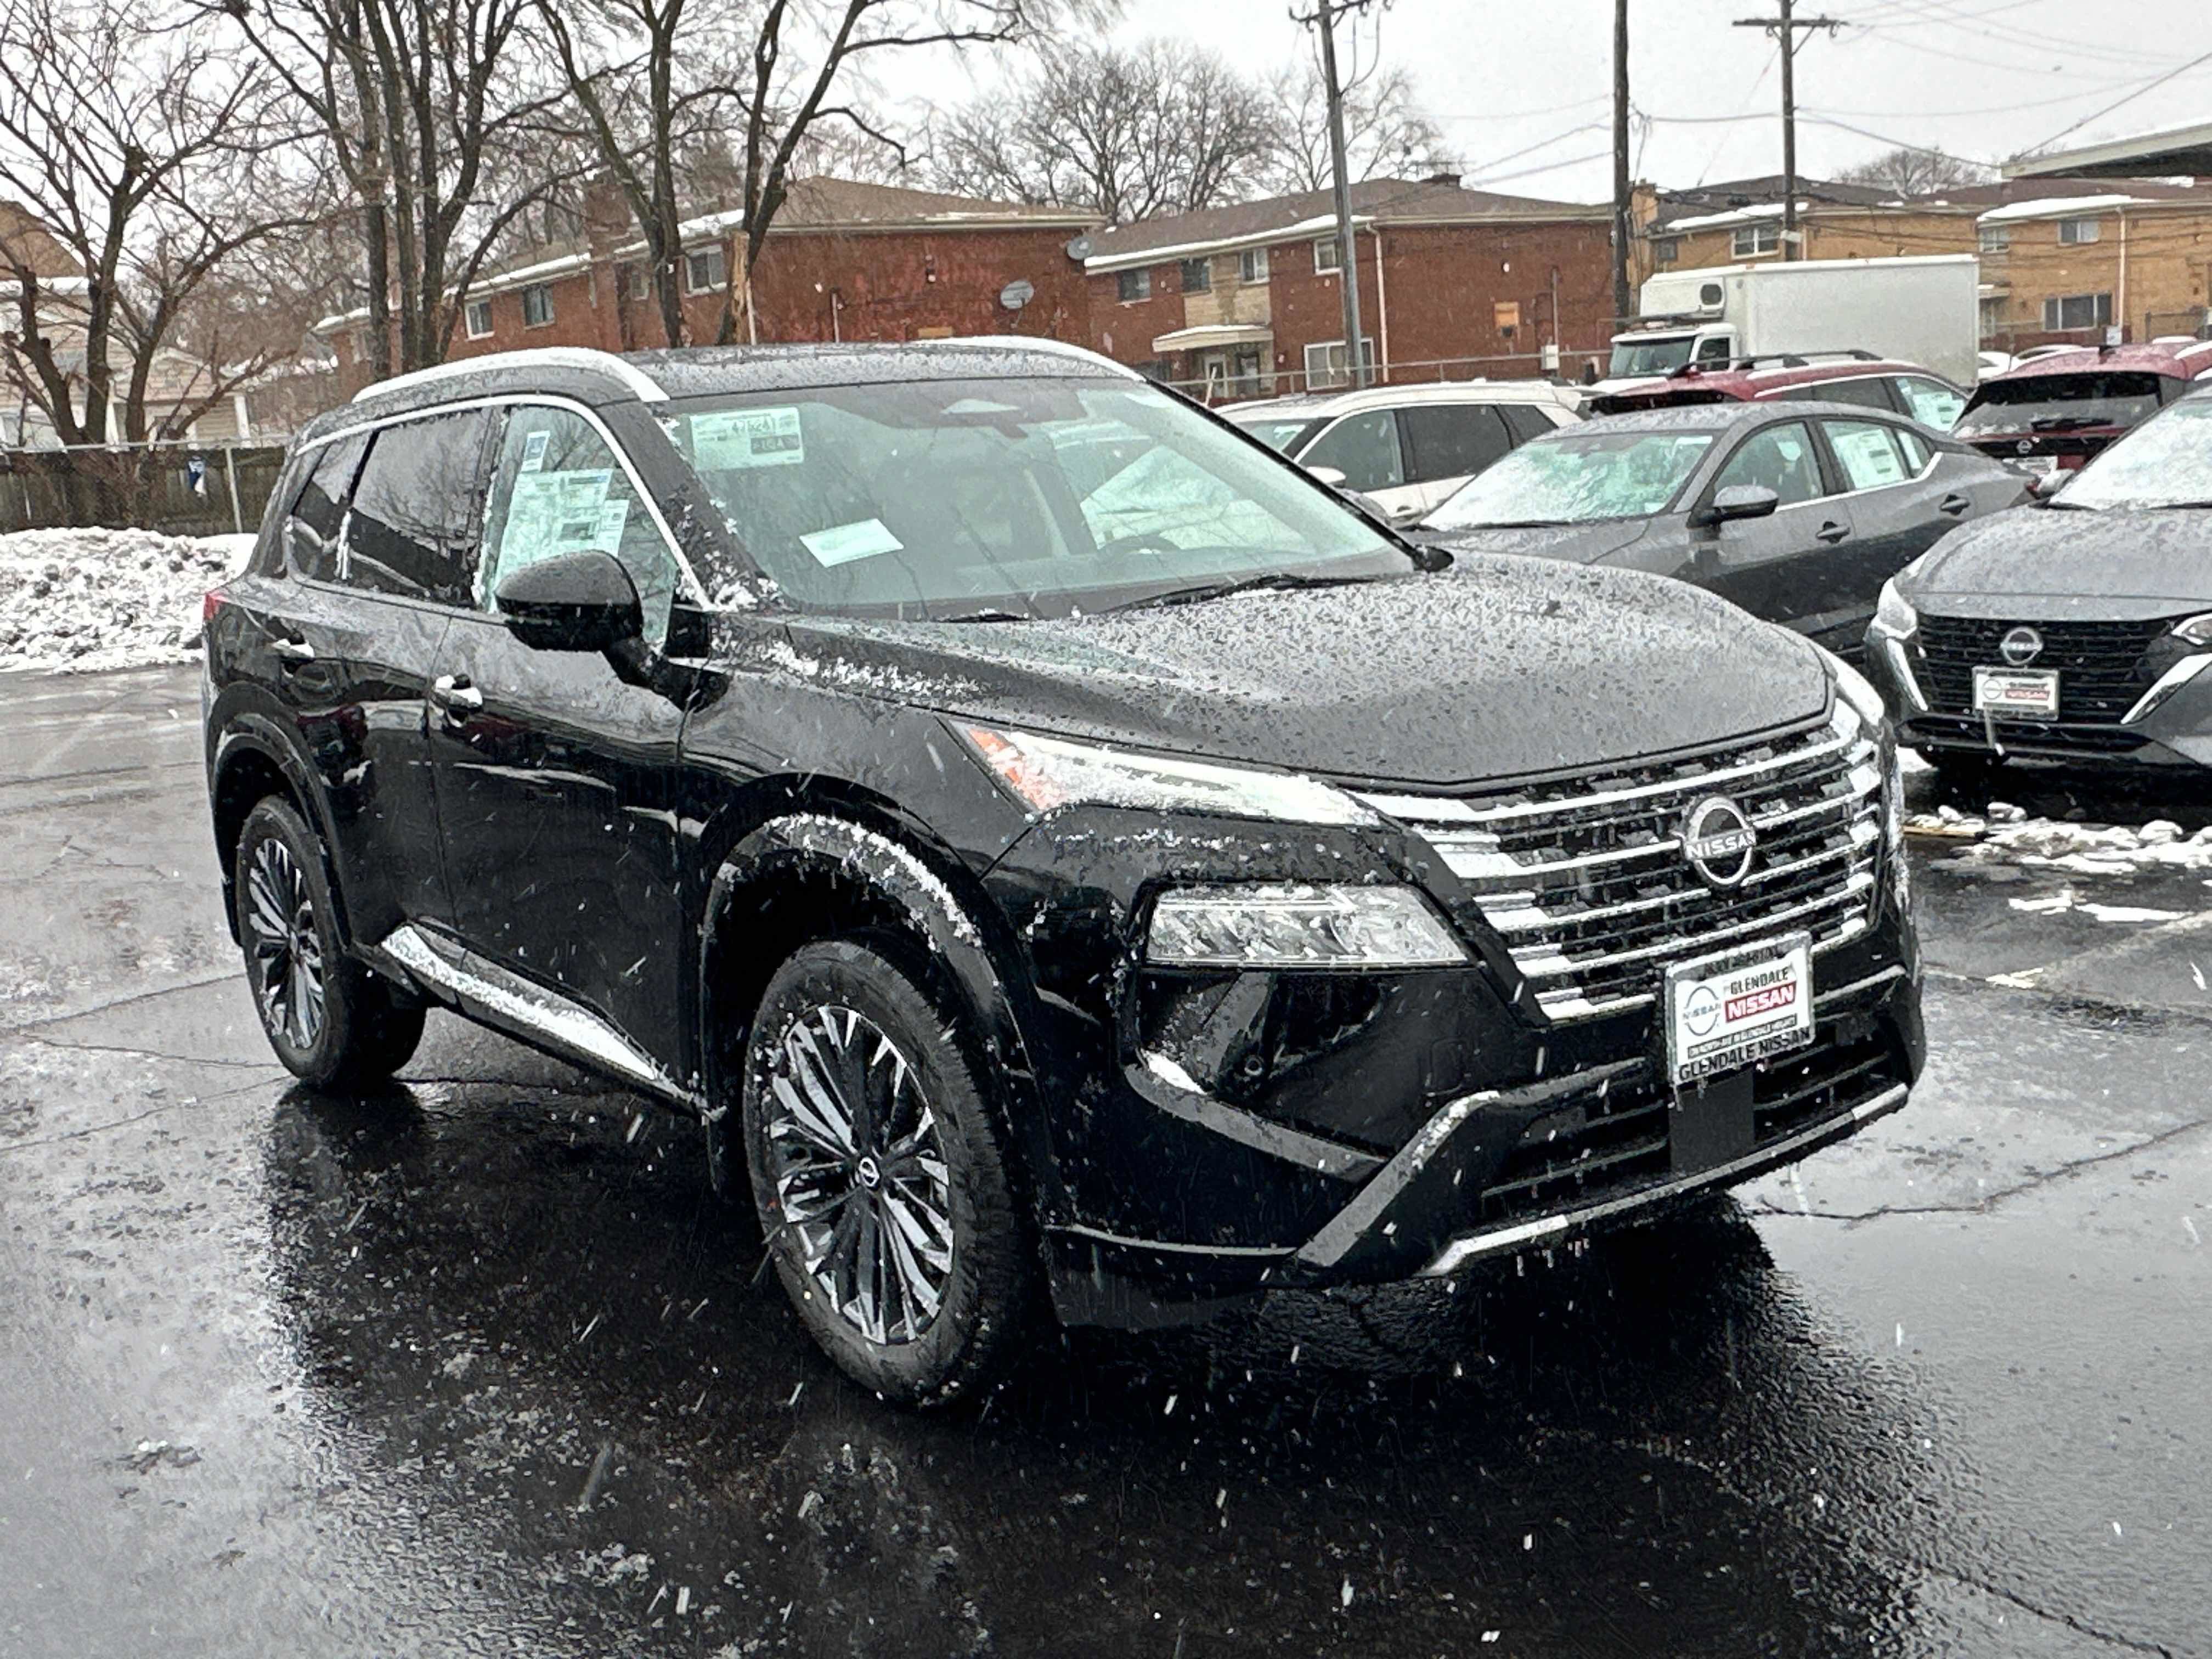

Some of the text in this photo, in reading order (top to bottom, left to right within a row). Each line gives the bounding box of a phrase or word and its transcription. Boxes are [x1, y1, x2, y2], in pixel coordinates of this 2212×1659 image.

[1685, 832, 1756, 860] NISSAN
[1731, 966, 1788, 995] GLENDALE
[1682, 1002, 1722, 1020] NISSAN
[1728, 984, 1795, 1019] NISSAN
[1679, 1043, 1756, 1081] GLENDALE
[1759, 1027, 1810, 1056] NISSAN
